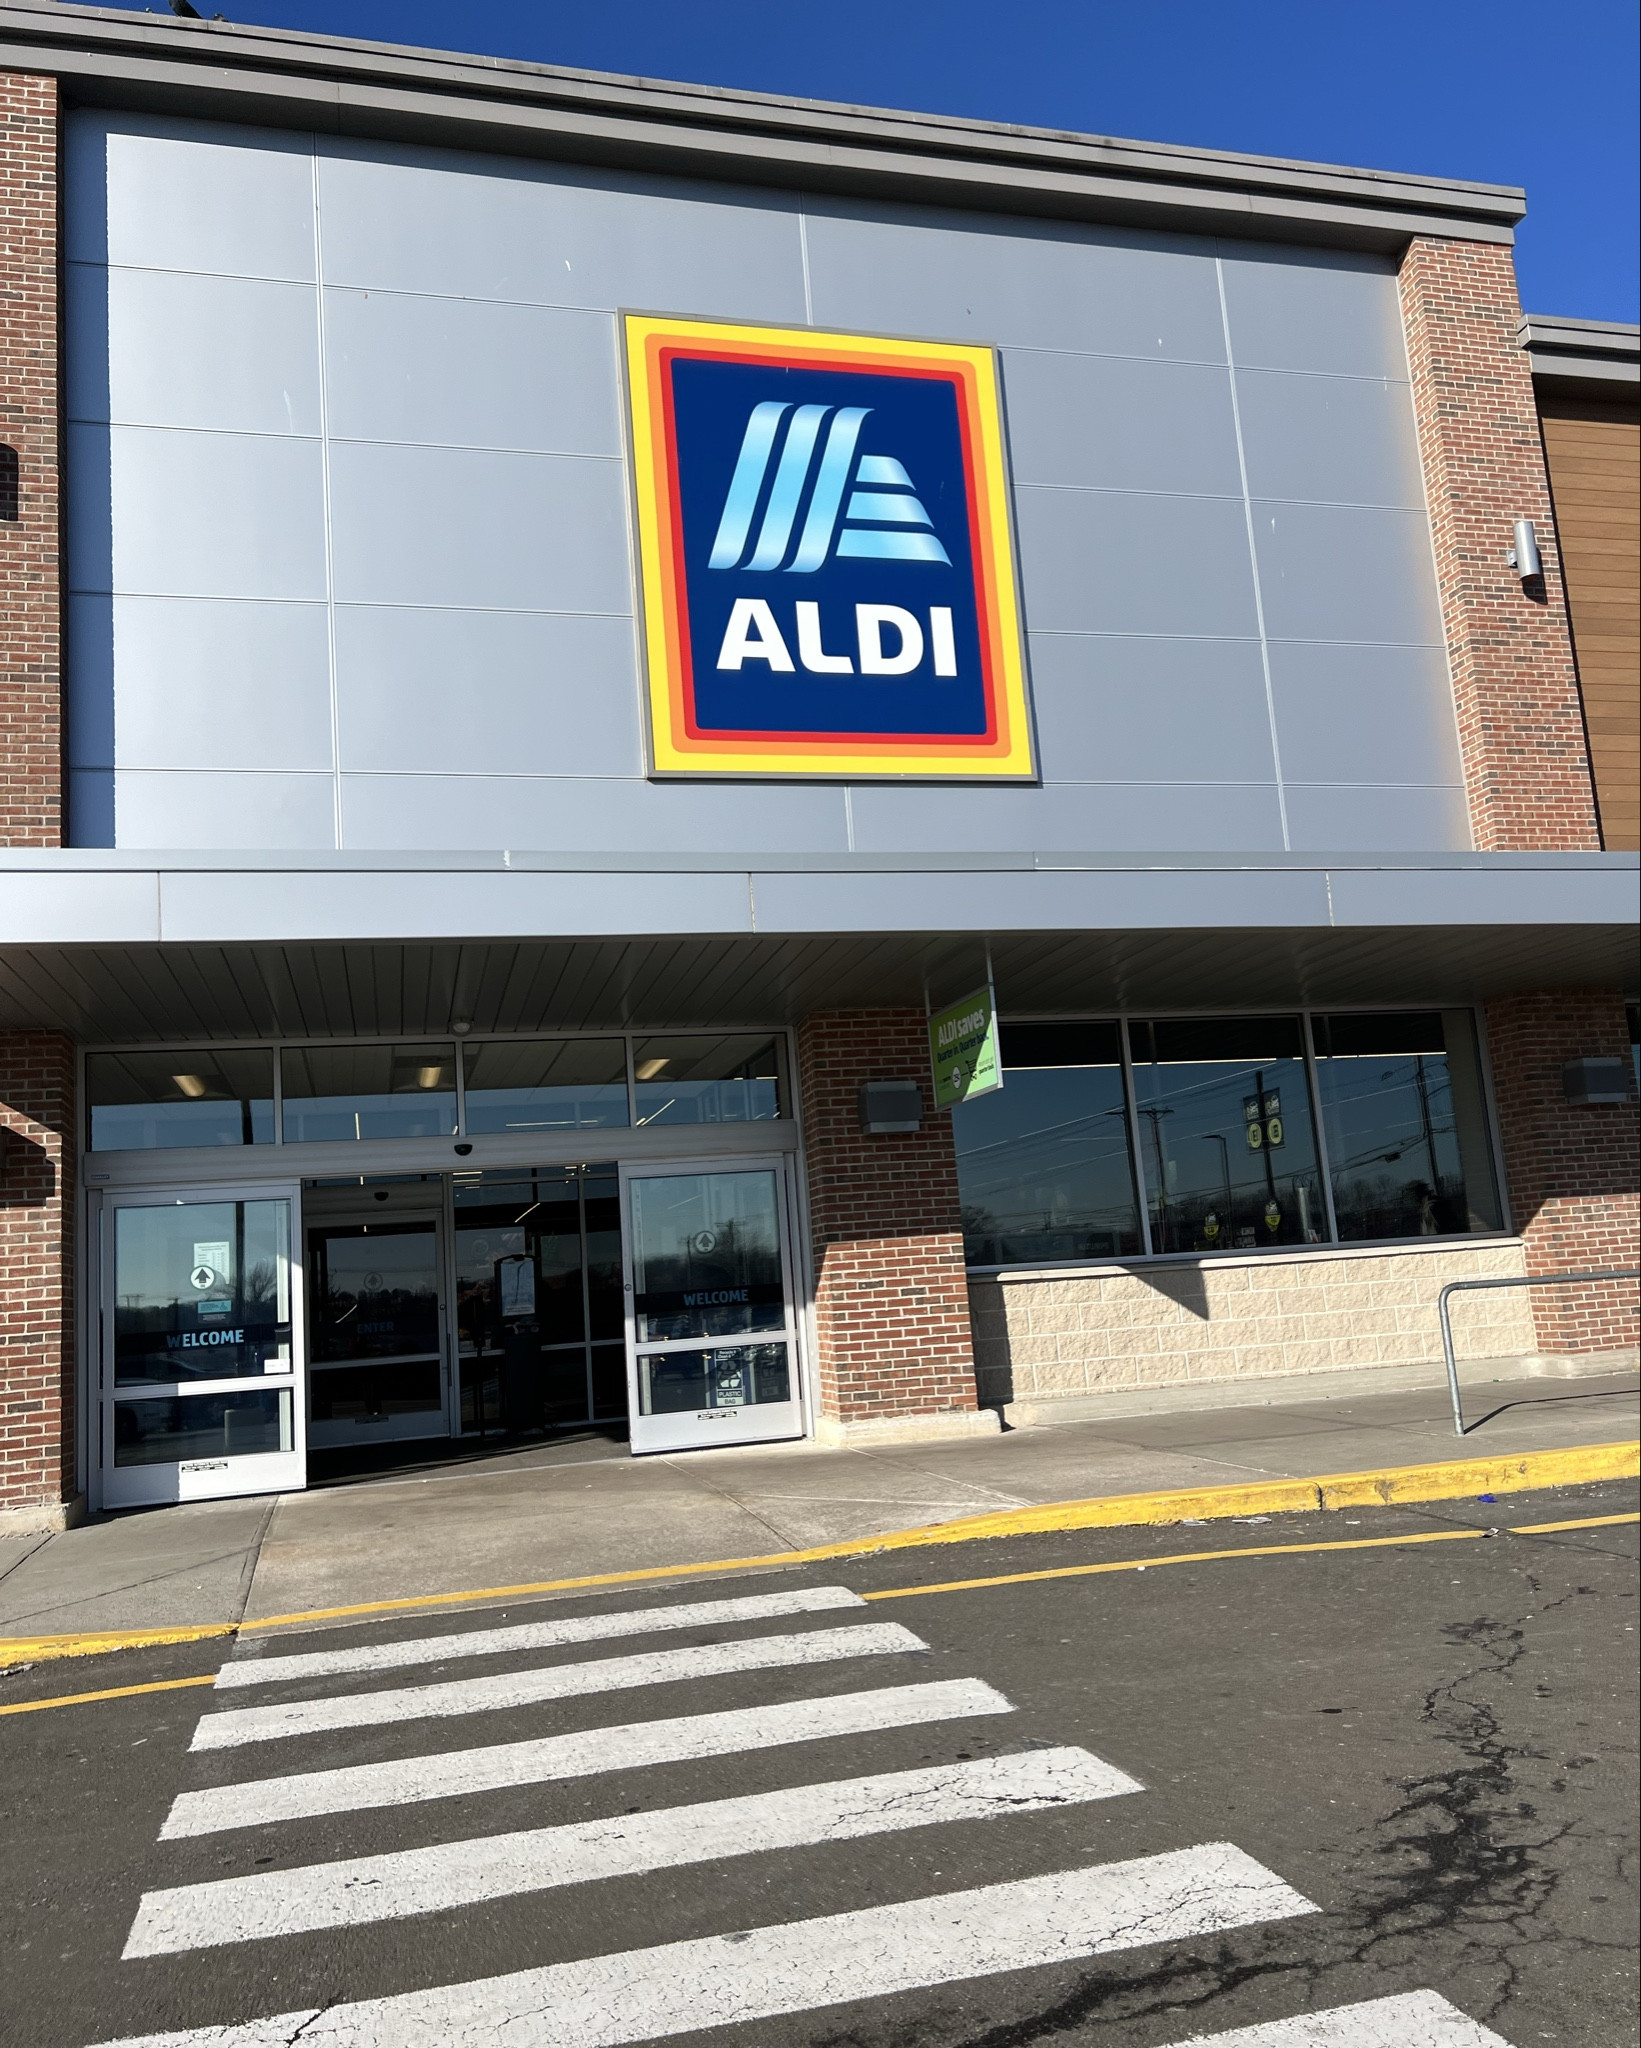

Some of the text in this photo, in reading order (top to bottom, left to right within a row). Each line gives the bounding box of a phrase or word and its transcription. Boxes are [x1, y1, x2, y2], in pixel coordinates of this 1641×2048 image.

[716, 598, 958, 677] ALDI
[938, 1008, 985, 1048] ALDI saves
[683, 1289, 749, 1306] WELCOME
[357, 1321, 394, 1333] ENTER
[166, 1329, 245, 1348] WELCOME
